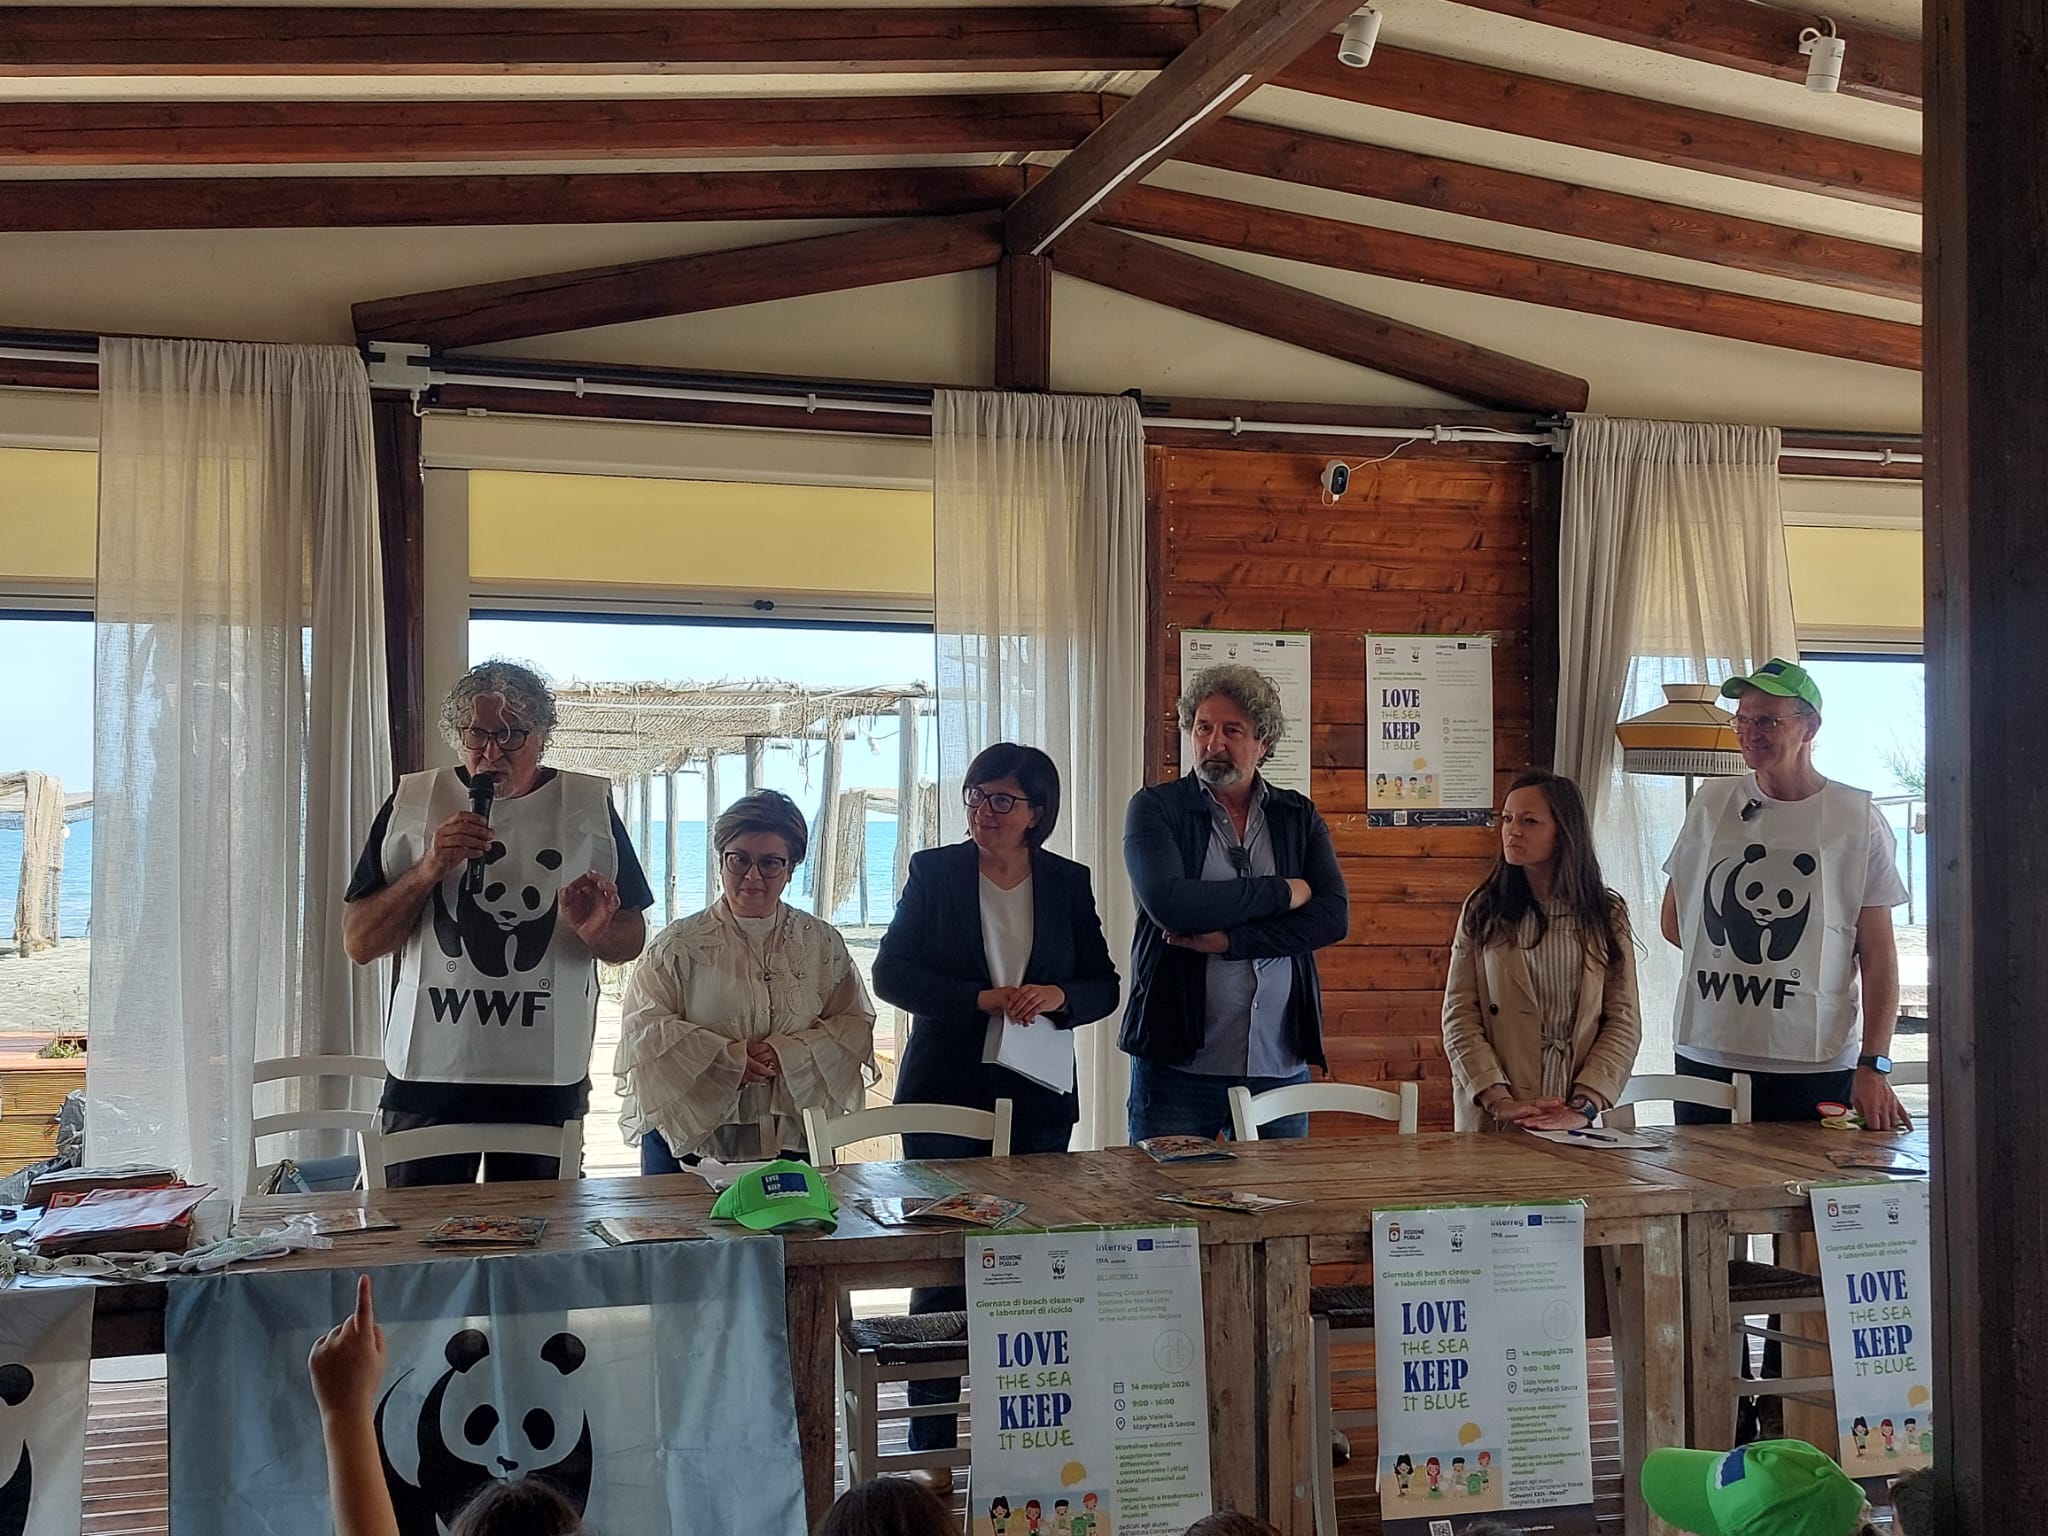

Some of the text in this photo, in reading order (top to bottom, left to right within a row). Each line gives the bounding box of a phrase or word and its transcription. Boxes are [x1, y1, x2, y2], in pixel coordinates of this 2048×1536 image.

[1382, 689, 1420, 708] LOVE
[1382, 710, 1420, 719] THE SEA
[1382, 722, 1420, 739] KEEP
[1382, 741, 1421, 750] IT BLUE
[1697, 970, 1800, 1009] WWF
[428, 987, 551, 1027] WWF
[1096, 1243, 1132, 1252] Interreg
[1401, 1278, 1437, 1287] laboratori
[1846, 1269, 1908, 1304] LOVE
[976, 1300, 1011, 1308] Giornata
[1022, 1297, 1047, 1305] beach
[1049, 1296, 1085, 1304] clean-up
[996, 1307, 1036, 1316] laboratori
[1401, 1300, 1467, 1335] LOVE
[1849, 1305, 1912, 1324] THE SEA
[997, 1330, 1069, 1367] LOVE
[1400, 1338, 1469, 1355] THE SEA
[1852, 1324, 1913, 1359] KEEP
[1854, 1356, 1918, 1376] IT BLUE
[996, 1371, 1072, 1390] THE SEA
[1403, 1359, 1468, 1393] KEEP
[1141, 1382, 1169, 1390] maggio
[999, 1392, 1072, 1430] KEEP
[1402, 1392, 1470, 1412] IT BLUE
[998, 1429, 1074, 1450] IT BLUE
